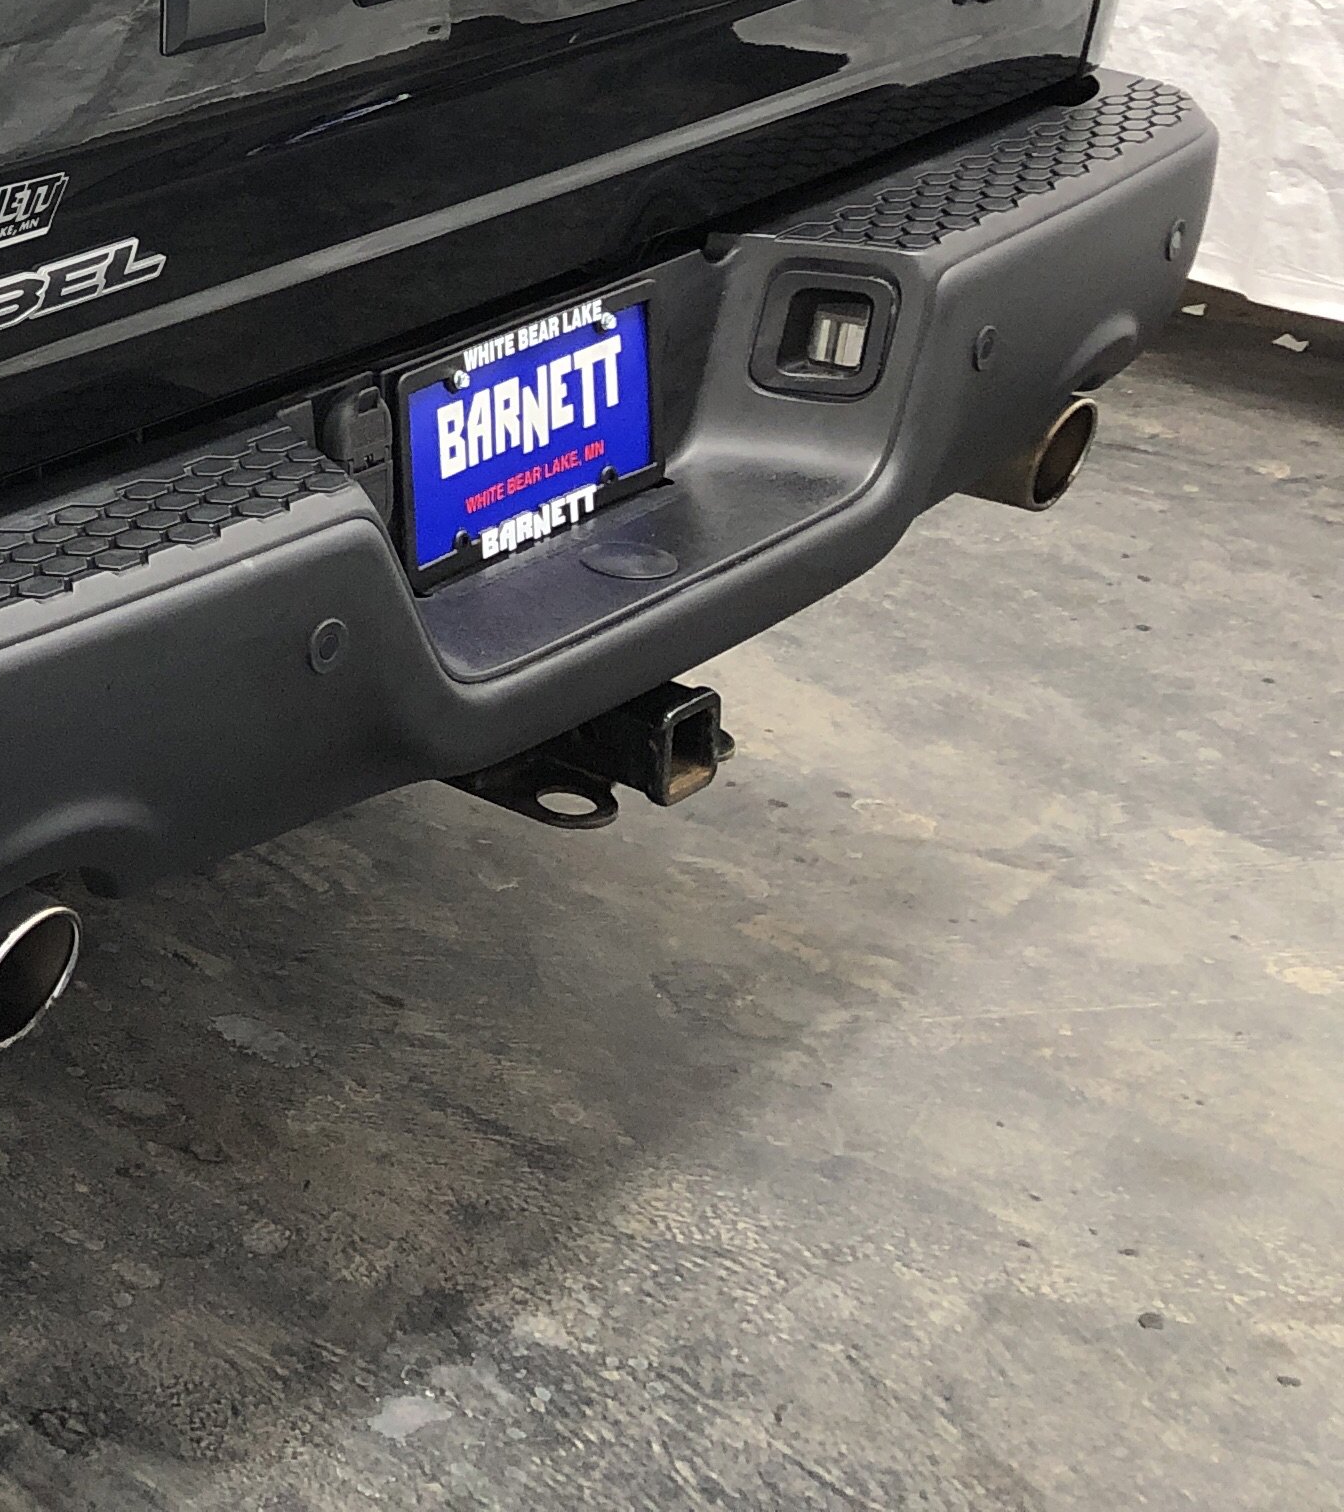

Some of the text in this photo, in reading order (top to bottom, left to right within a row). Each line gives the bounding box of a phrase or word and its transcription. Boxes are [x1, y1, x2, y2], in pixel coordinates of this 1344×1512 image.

[19, 217, 40, 233] MN
[463, 335, 516, 372] WHITE
[517, 317, 560, 350] BEAR
[436, 334, 622, 480] BARNETT
[465, 439, 605, 514] WHITE BEAR LAKE, MN
[481, 484, 598, 560] BARNETT
